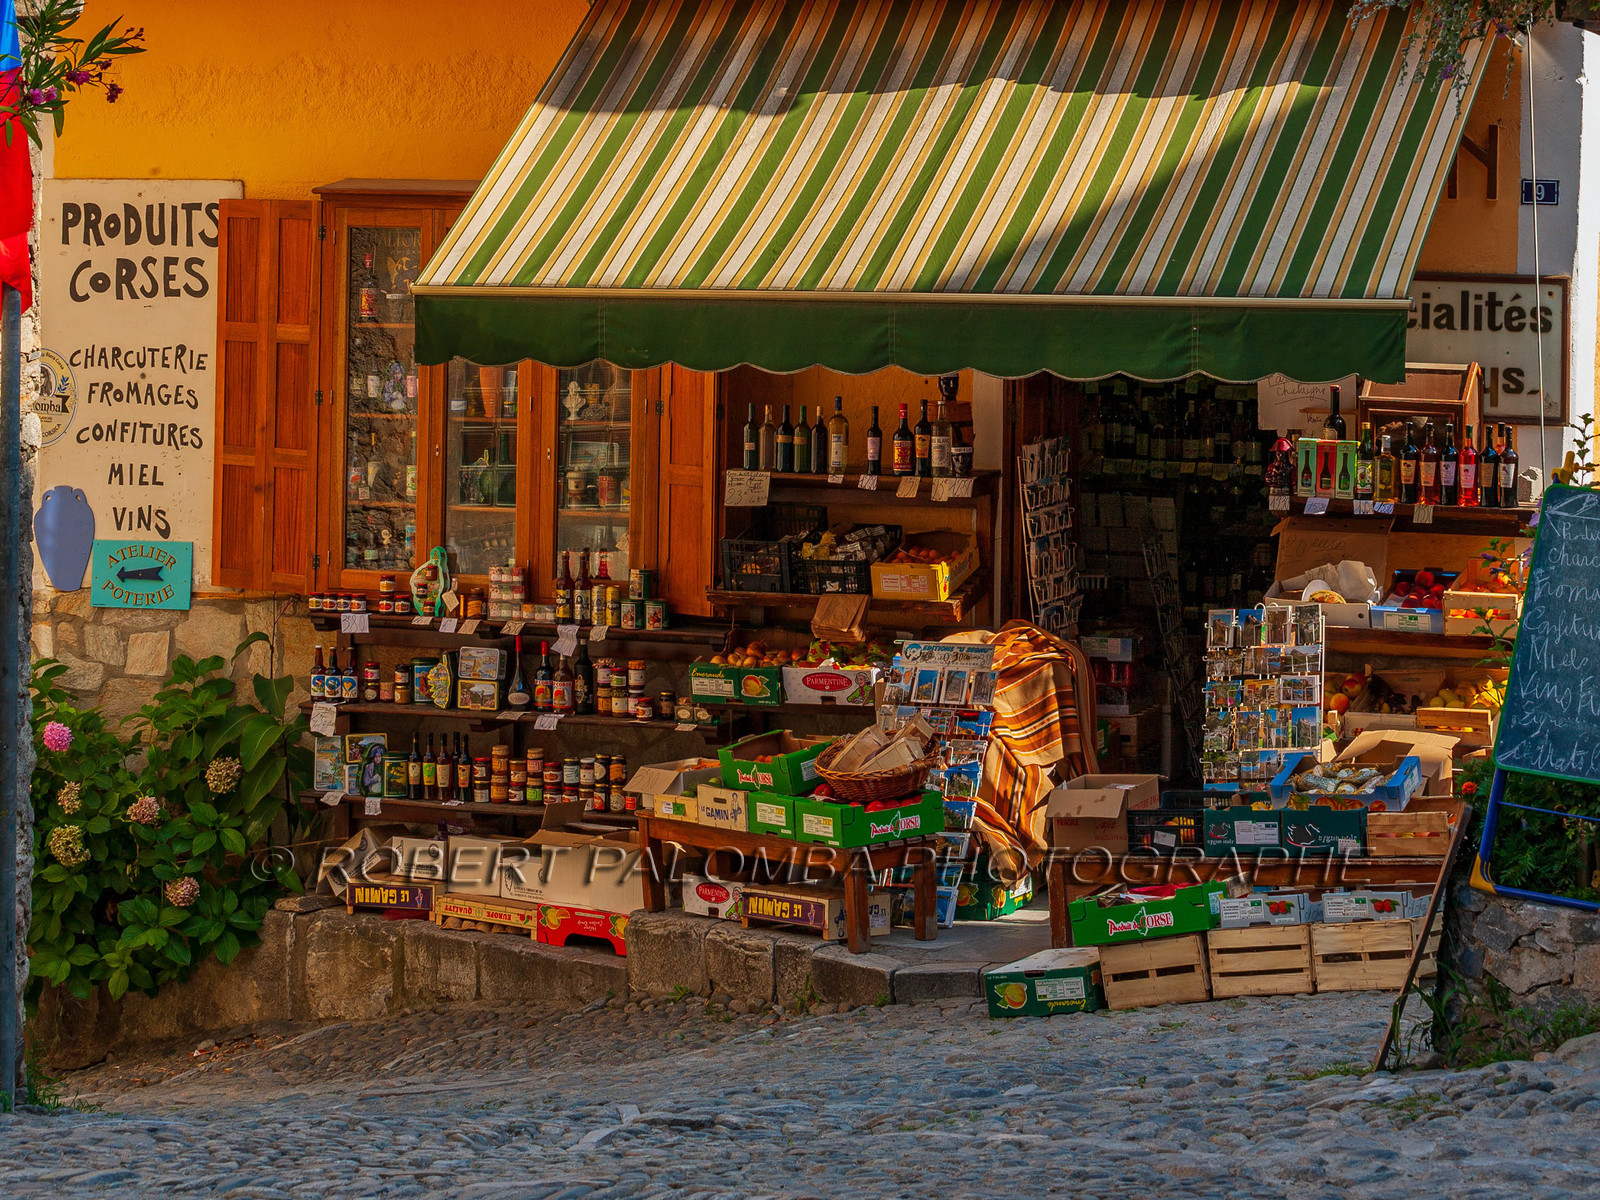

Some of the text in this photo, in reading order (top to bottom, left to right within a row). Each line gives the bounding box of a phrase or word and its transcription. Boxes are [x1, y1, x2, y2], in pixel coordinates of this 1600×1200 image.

[1536, 184, 1545, 201] 9
[69, 257, 210, 302] CORSES
[69, 344, 208, 373] CHARCUTERIE
[87, 382, 199, 410] FROMAGES
[76, 419, 204, 450] CONFITURES
[108, 463, 164, 486] MIEL
[112, 505, 171, 539] VINS
[107, 544, 177, 571] ATELIER
[101, 579, 175, 606] POTERIE
[806, 677, 849, 687] PARMENTINE
[705, 807, 729, 821] GAMIN
[895, 815, 920, 831] CORSE
[355, 887, 410, 904] LE GAMIN
[444, 905, 512, 921] EUROPE QUALITY
[748, 896, 802, 918] LE GAMIN
[1140, 912, 1173, 928] CORSE
